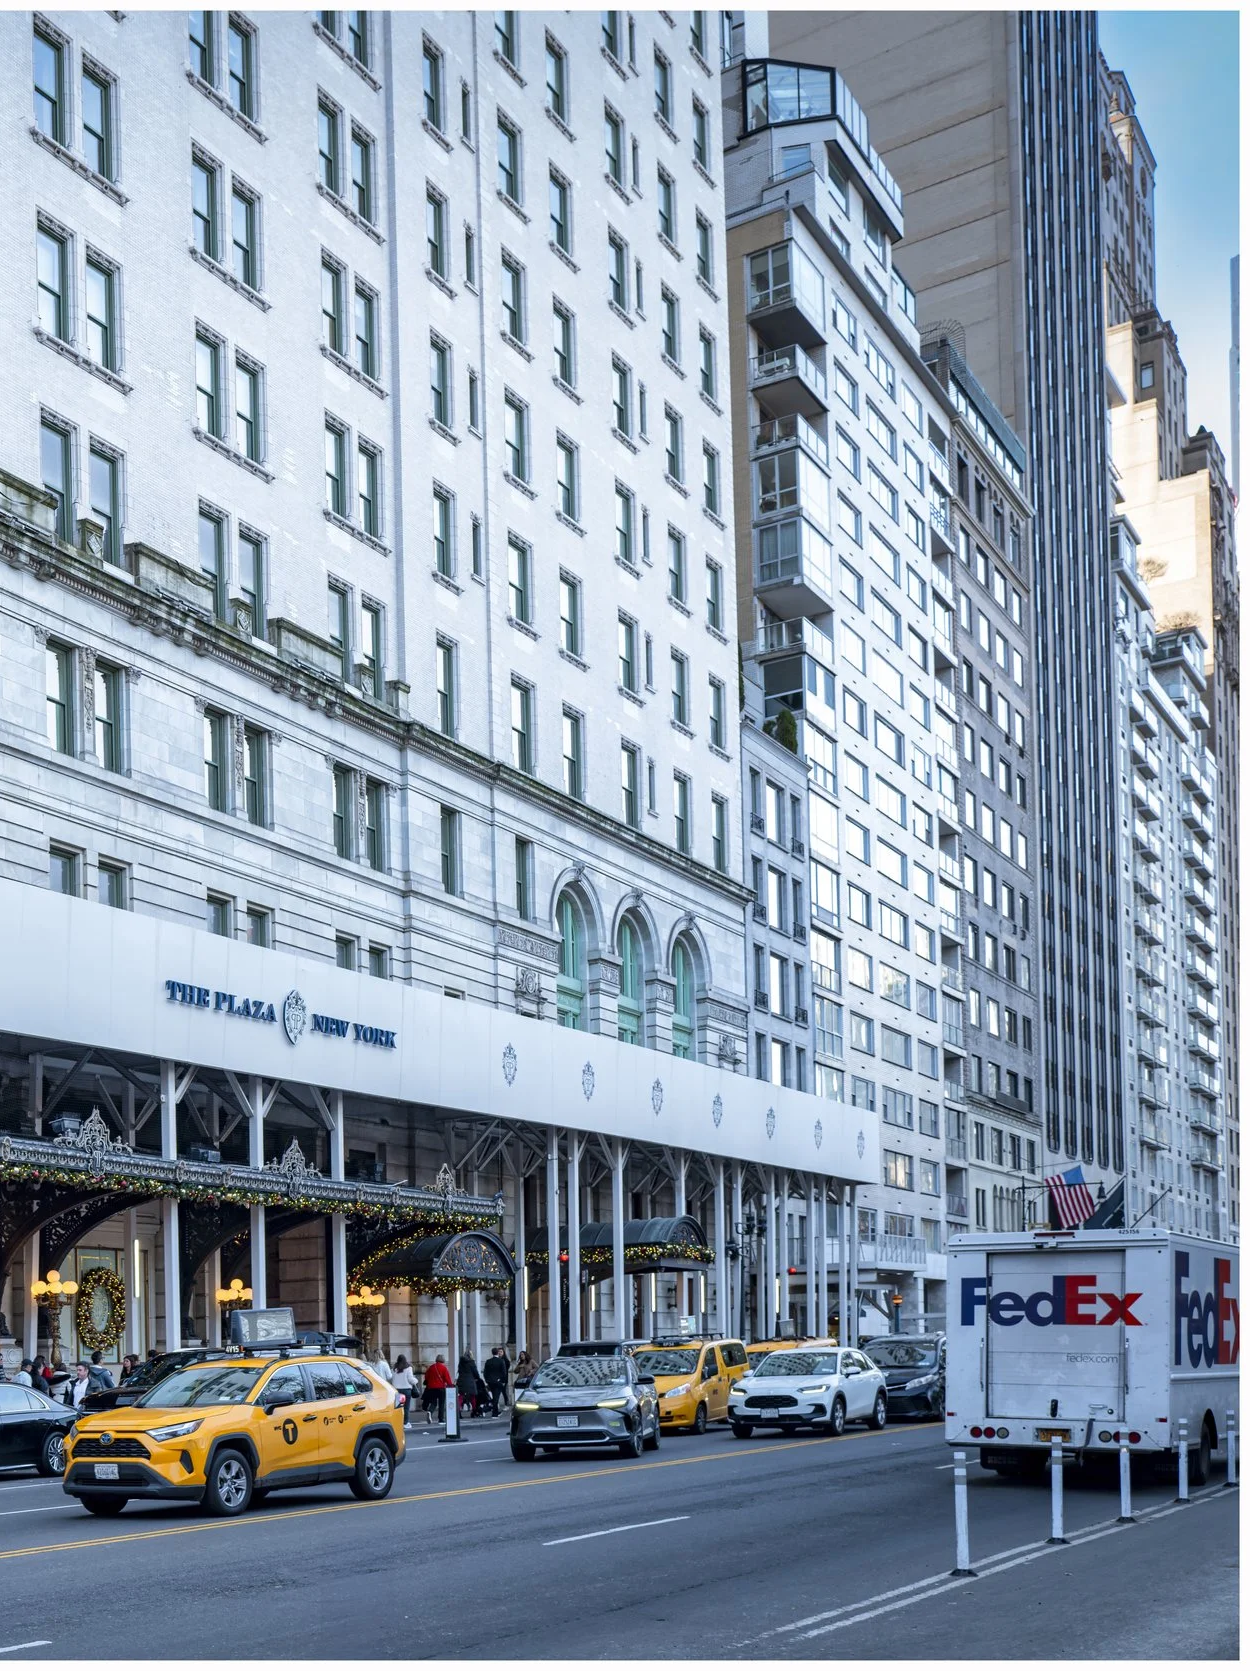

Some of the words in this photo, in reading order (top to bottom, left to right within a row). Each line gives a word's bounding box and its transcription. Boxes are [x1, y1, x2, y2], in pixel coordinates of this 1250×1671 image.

[165, 979, 210, 1008] THE
[213, 990, 278, 1023] PLAZA
[310, 1013, 350, 1038] NEW
[352, 1022, 398, 1049] YORK
[961, 1275, 1143, 1326] FedEx
[1066, 1353, 1119, 1364] fedex.com
